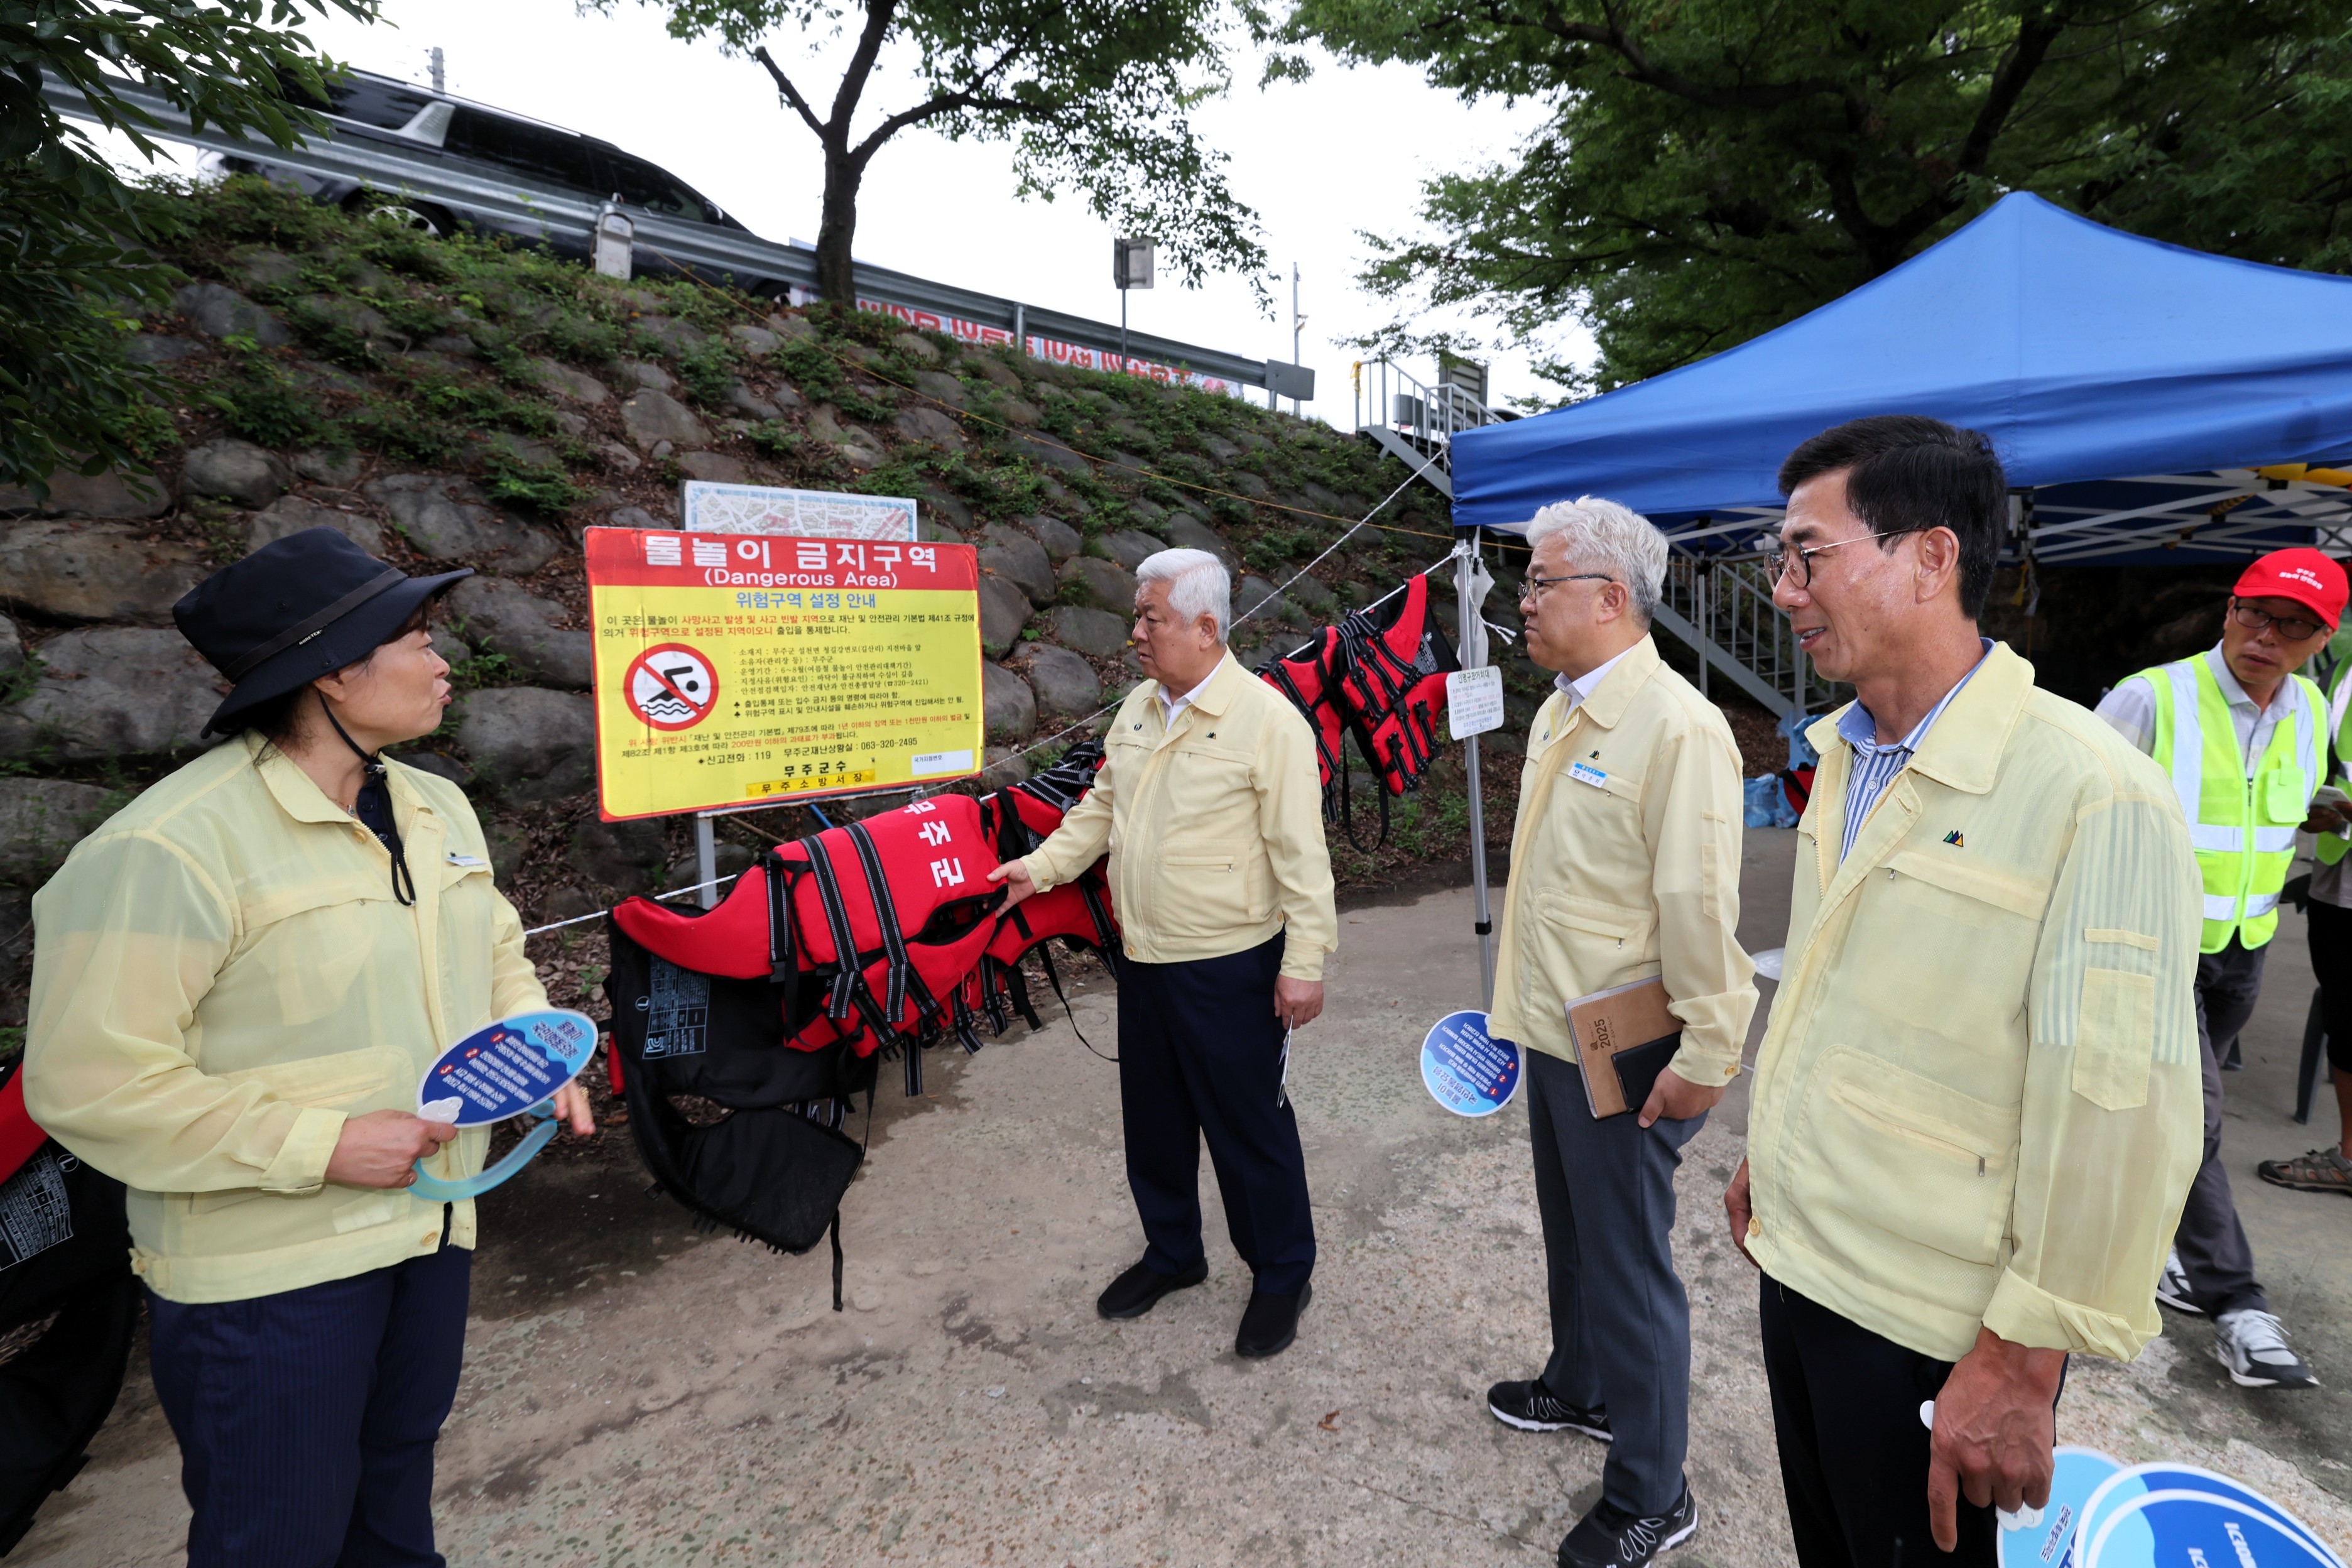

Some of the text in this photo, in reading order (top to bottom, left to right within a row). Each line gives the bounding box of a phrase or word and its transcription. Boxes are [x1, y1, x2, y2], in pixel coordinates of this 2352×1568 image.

[645, 535, 936, 573] 물놀이 금지구역
[704, 568, 898, 589] (Dangerous Area)
[736, 591, 876, 609] 위험구역 설정 안내
[607, 616, 617, 626] 이
[648, 615, 677, 625] 물놀이
[682, 615, 720, 624] 사망사고
[724, 615, 743, 624] 발생
[747, 615, 756, 624] 및
[760, 615, 777, 624] 사고
[781, 615, 798, 624] 빈발
[802, 614, 836, 623] 지역으로
[839, 614, 855, 623] 재난
[858, 614, 866, 623] 및
[869, 614, 900, 623] 안전관리
[903, 614, 925, 623] 기본법
[928, 614, 951, 623] 제41조
[954, 614, 974, 623] 규정에
[603, 626, 851, 638] 의거 위험구역으로 설정된 지역이오니 출입을 통제합니다.
[739, 648, 762, 656] 소재지
[798, 646, 820, 655] 설천면
[886, 644, 912, 652] 지전마을
[740, 662, 912, 676] 운영기간 6~8월(여름철 물놀이 안전관리대책기간)
[792, 656, 802, 665] 등)
[741, 675, 807, 685] 지정사유(위험요인)
[817, 673, 838, 682] 바닥이
[842, 672, 876, 681] 불규칙하며
[741, 685, 798, 695] 안전점검책임자:
[801, 683, 837, 692] 안전재난과
[841, 680, 881, 690] 안전총괄담당
[744, 699, 775, 708] 출입통제
[778, 697, 793, 705] 또는
[795, 697, 810, 705] 입수
[813, 695, 827, 704] 금지
[830, 695, 844, 703] 등의
[846, 694, 866, 702] 명령에
[744, 709, 775, 717] 위험구역
[778, 707, 793, 716] 표시
[796, 706, 803, 714] 및
[806, 704, 841, 714] 안내시설을
[844, 702, 878, 710] 훼손하거나
[880, 699, 912, 708] 위험구역에
[915, 697, 945, 706] 진입해서는
[956, 695, 964, 704] 됨.
[628, 738, 637, 747] 위
[662, 736, 687, 744] 위반시
[724, 729, 754, 739] 안전관리
[787, 725, 817, 734] 제79조에
[820, 724, 834, 732] 따라
[851, 721, 871, 729] 이하의
[905, 716, 927, 725] 1천만원
[950, 714, 962, 722] 벌금
[621, 731, 858, 758] 제82조 제1항 제3호에 따라 200만원 이하의 과태료가 부과됩니다.
[706, 737, 918, 766] 신고전화 119 무주군재난상황실 063-320-2495
[784, 760, 846, 777] 무주군수
[761, 771, 863, 793] 무주소방서장
[903, 800, 965, 888] 무주군
[1593, 1018, 1611, 1049] 2025
[1437, 1084, 1461, 1104] 물놀이
